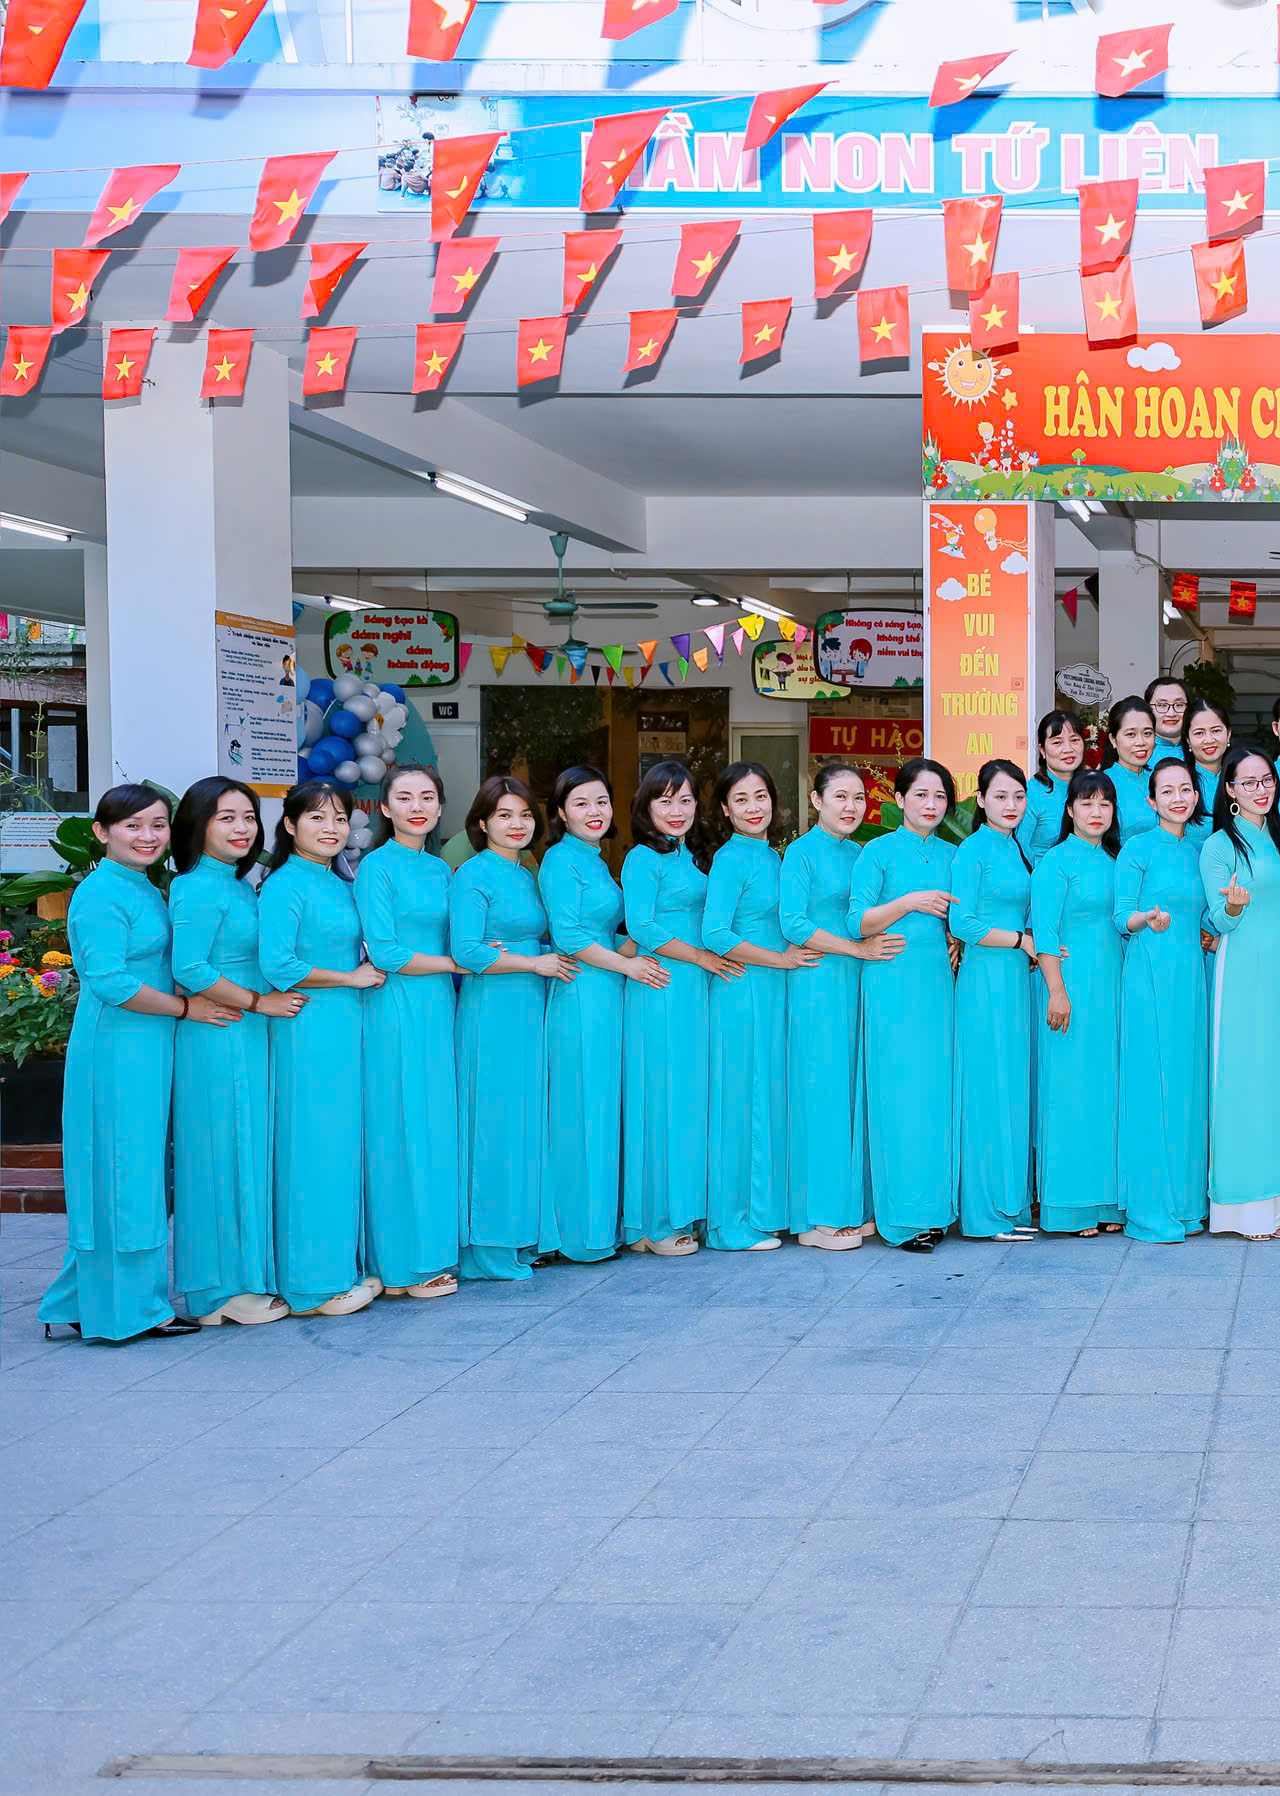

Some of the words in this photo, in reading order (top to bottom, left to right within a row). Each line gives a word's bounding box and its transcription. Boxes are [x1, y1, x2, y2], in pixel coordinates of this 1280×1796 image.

[581, 112, 762, 192] ẦM
[781, 132, 935, 193] NON
[951, 121, 1050, 194] TỨ
[1060, 121, 1219, 194] LIÊN
[1043, 370, 1124, 438] HÂN
[1135, 386, 1241, 438] HOAN
[967, 569, 992, 597] BÉ
[394, 615, 414, 626] tạo
[417, 615, 428, 624] là
[845, 619, 872, 630] Không
[874, 619, 883, 628] có
[885, 620, 905, 631] sáng
[964, 613, 995, 637] VUI
[351, 629, 380, 640] dám
[383, 630, 412, 644] nghĩ
[905, 633, 920, 642] thể
[406, 645, 433, 655] dám
[898, 648, 909, 656] vui
[387, 659, 418, 669] hành
[421, 660, 450, 673] động
[960, 646, 999, 676] ĐẾN
[439, 706, 453, 716] WC
[941, 688, 1018, 716] TRƯỜNG
[830, 725, 858, 751] TỰ
[871, 723, 923, 748] HÀO
[966, 732, 992, 755] AN
